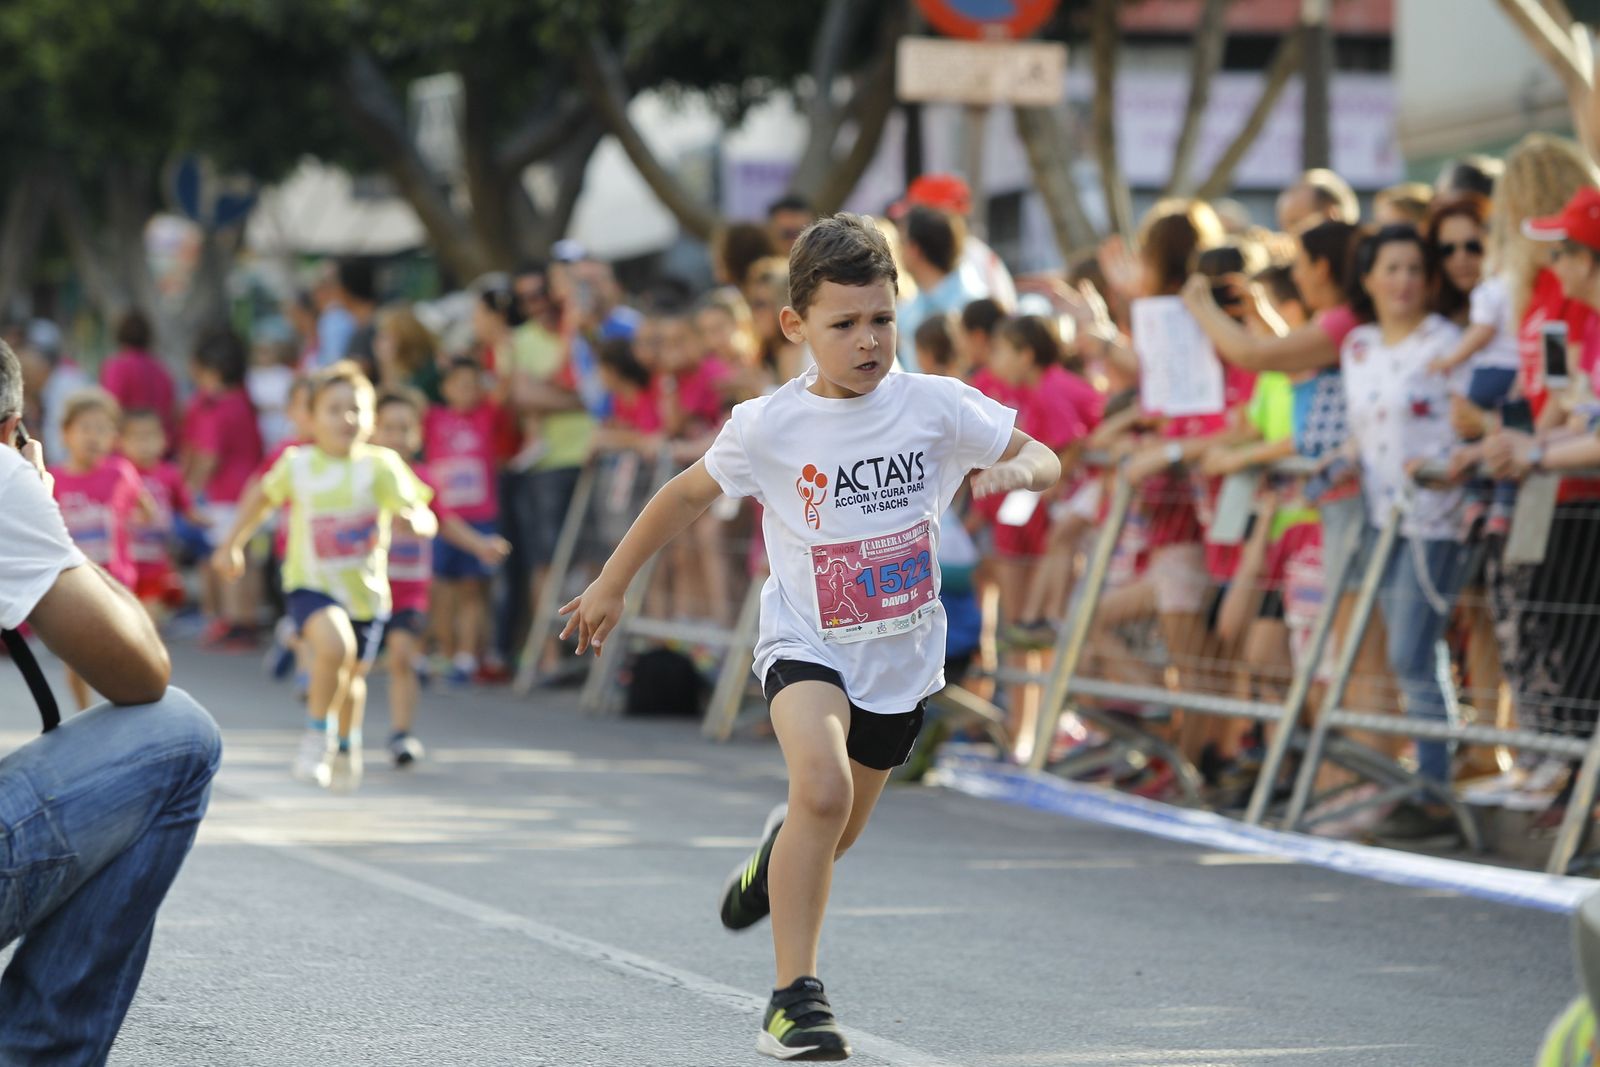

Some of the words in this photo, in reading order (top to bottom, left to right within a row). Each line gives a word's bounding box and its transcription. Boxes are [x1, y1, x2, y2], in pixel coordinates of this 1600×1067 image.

[834, 451, 925, 497] ACTAYS
[835, 491, 870, 508] ACCIÓN
[871, 491, 878, 500] Y
[880, 487, 905, 499] CURA
[907, 482, 925, 494] PARA
[860, 497, 909, 515] TAY-SACHS
[865, 536, 902, 551] CARRERA
[856, 550, 931, 598] 1522
[881, 593, 909, 608] DAVID
